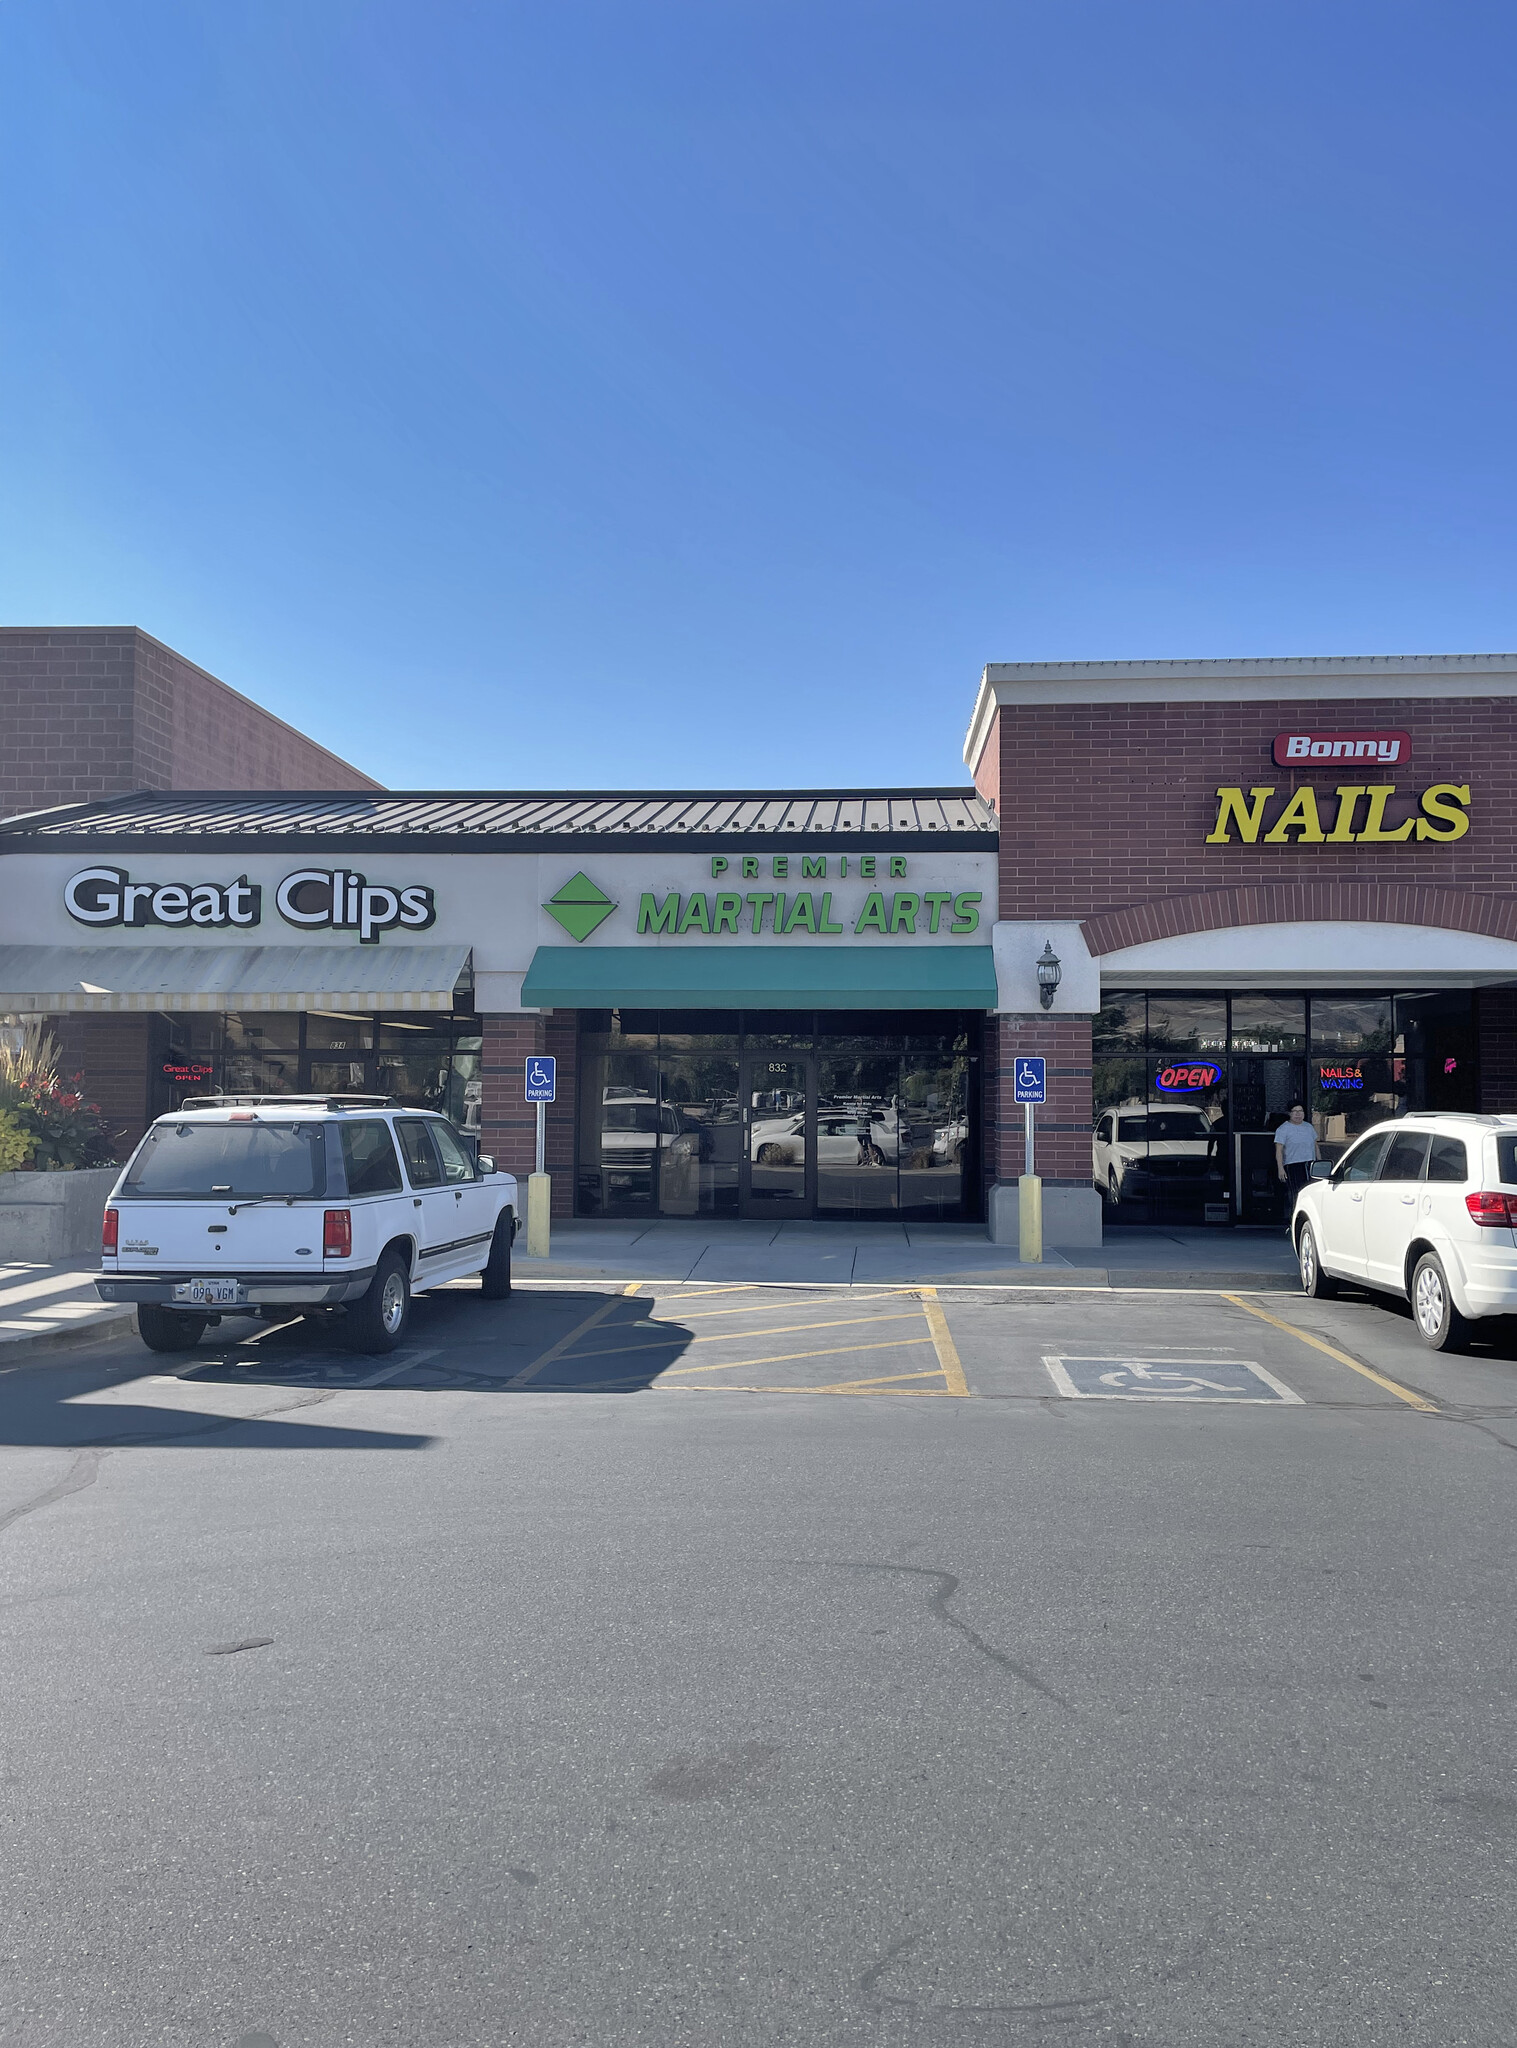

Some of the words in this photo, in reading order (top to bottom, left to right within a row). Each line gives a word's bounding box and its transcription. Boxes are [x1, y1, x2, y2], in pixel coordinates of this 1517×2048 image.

[1286, 736, 1400, 762] Bonny
[1205, 783, 1472, 843] NAILS
[711, 856, 907, 878] PREMIER
[63, 867, 259, 926] Great
[276, 870, 433, 941] Clips
[636, 892, 843, 934] MARTIAL
[854, 892, 983, 934] ARTS
[163, 1064, 189, 1073] Great
[191, 1064, 213, 1075] Clips
[768, 1063, 787, 1073] 832
[1160, 1068, 1215, 1087] OPEN
[1320, 1078, 1364, 1089] WAXING
[528, 1089, 553, 1097] PARKING
[1017, 1090, 1043, 1098] PARKING
[216, 1287, 234, 1300] VGM
